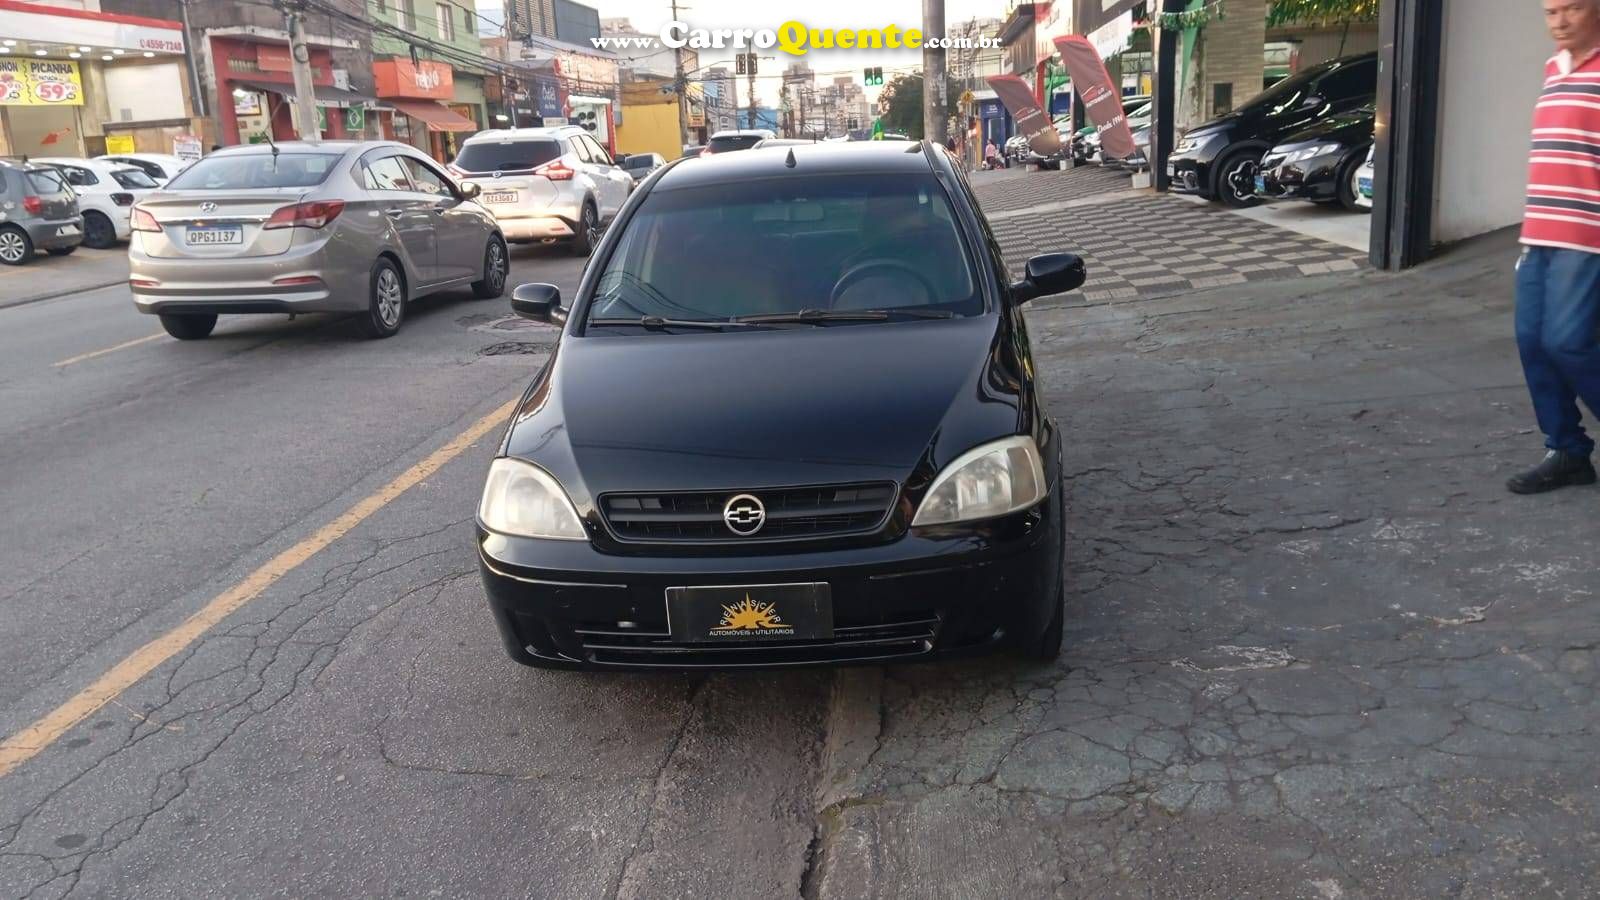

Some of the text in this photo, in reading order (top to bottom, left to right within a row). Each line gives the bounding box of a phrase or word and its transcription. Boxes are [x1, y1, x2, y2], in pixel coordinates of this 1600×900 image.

[30, 62, 74, 75] PICANHA
[40, 84, 65, 99] 59
[719, 599, 782, 626] RENASCER
